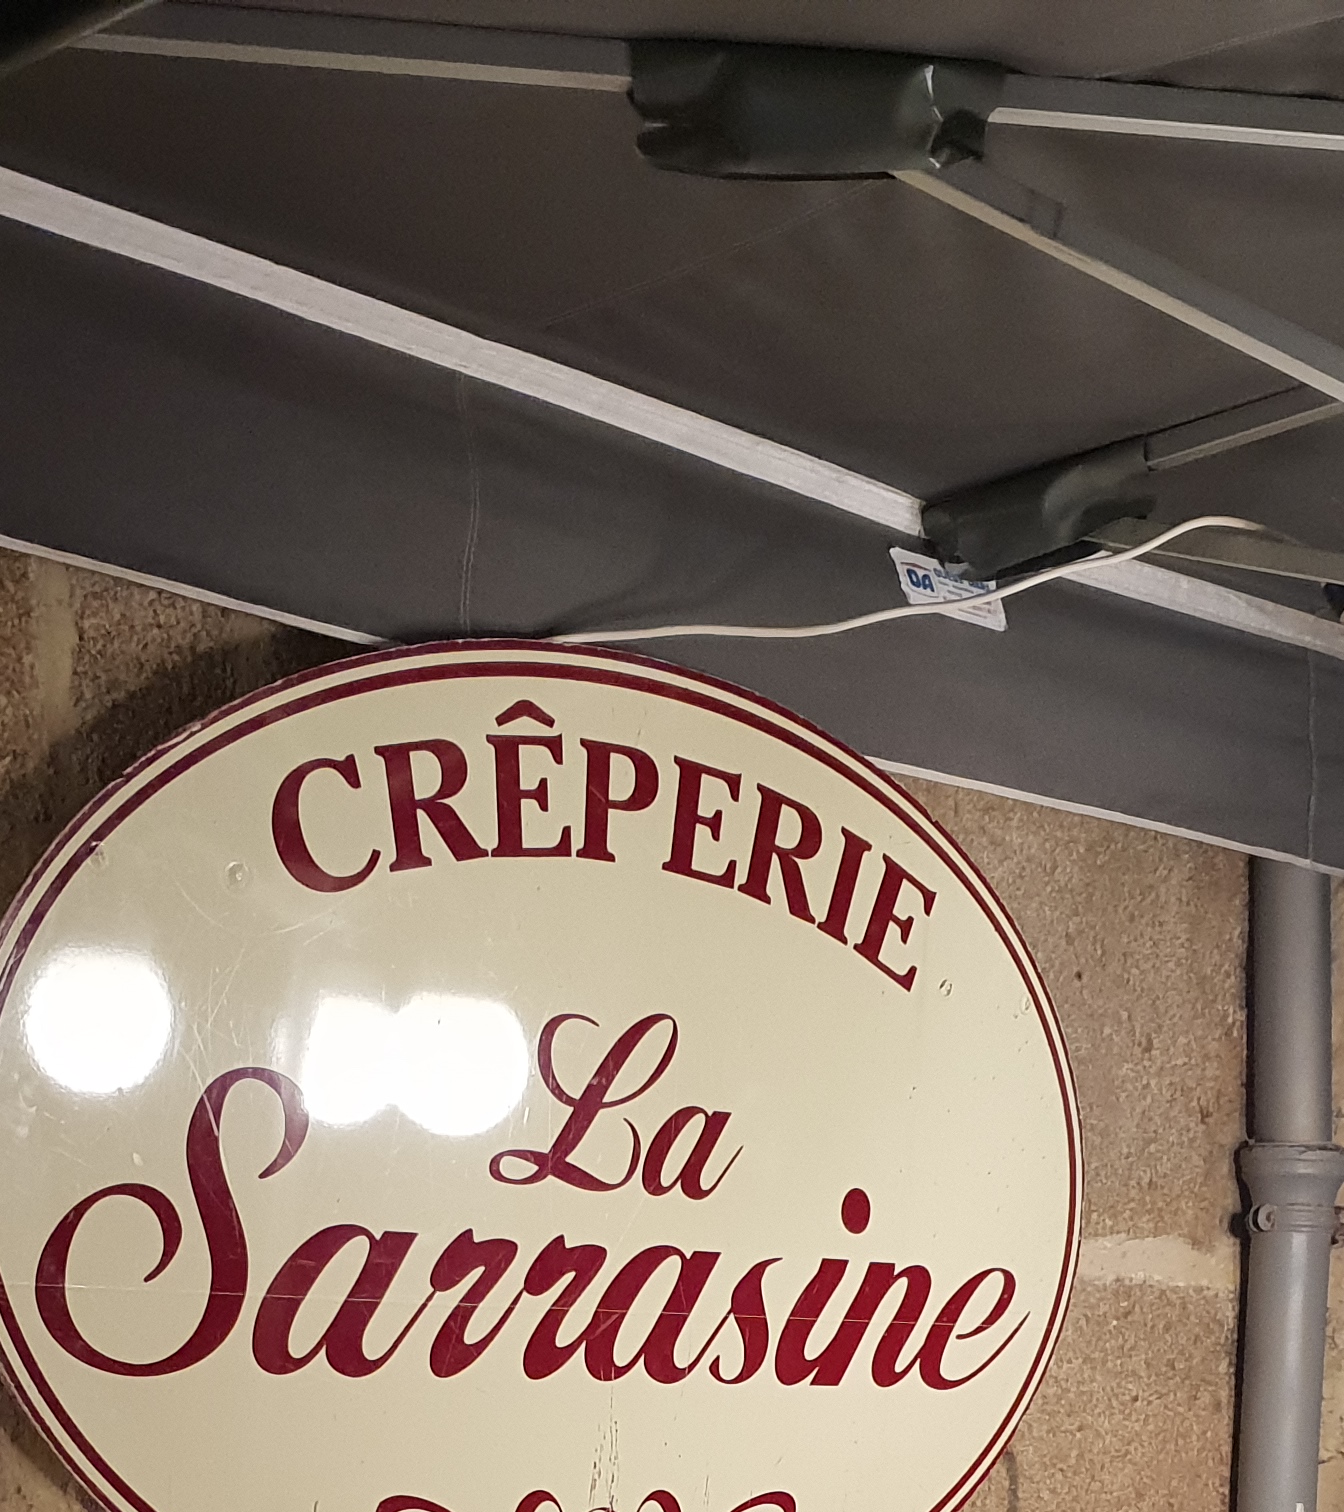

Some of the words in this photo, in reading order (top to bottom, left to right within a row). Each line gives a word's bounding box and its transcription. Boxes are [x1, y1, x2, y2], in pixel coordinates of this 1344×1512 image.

[270, 699, 937, 991] CRÊPERIE
[34, 1065, 1030, 1391] Sarrasine
[488, 1012, 744, 1201] La
